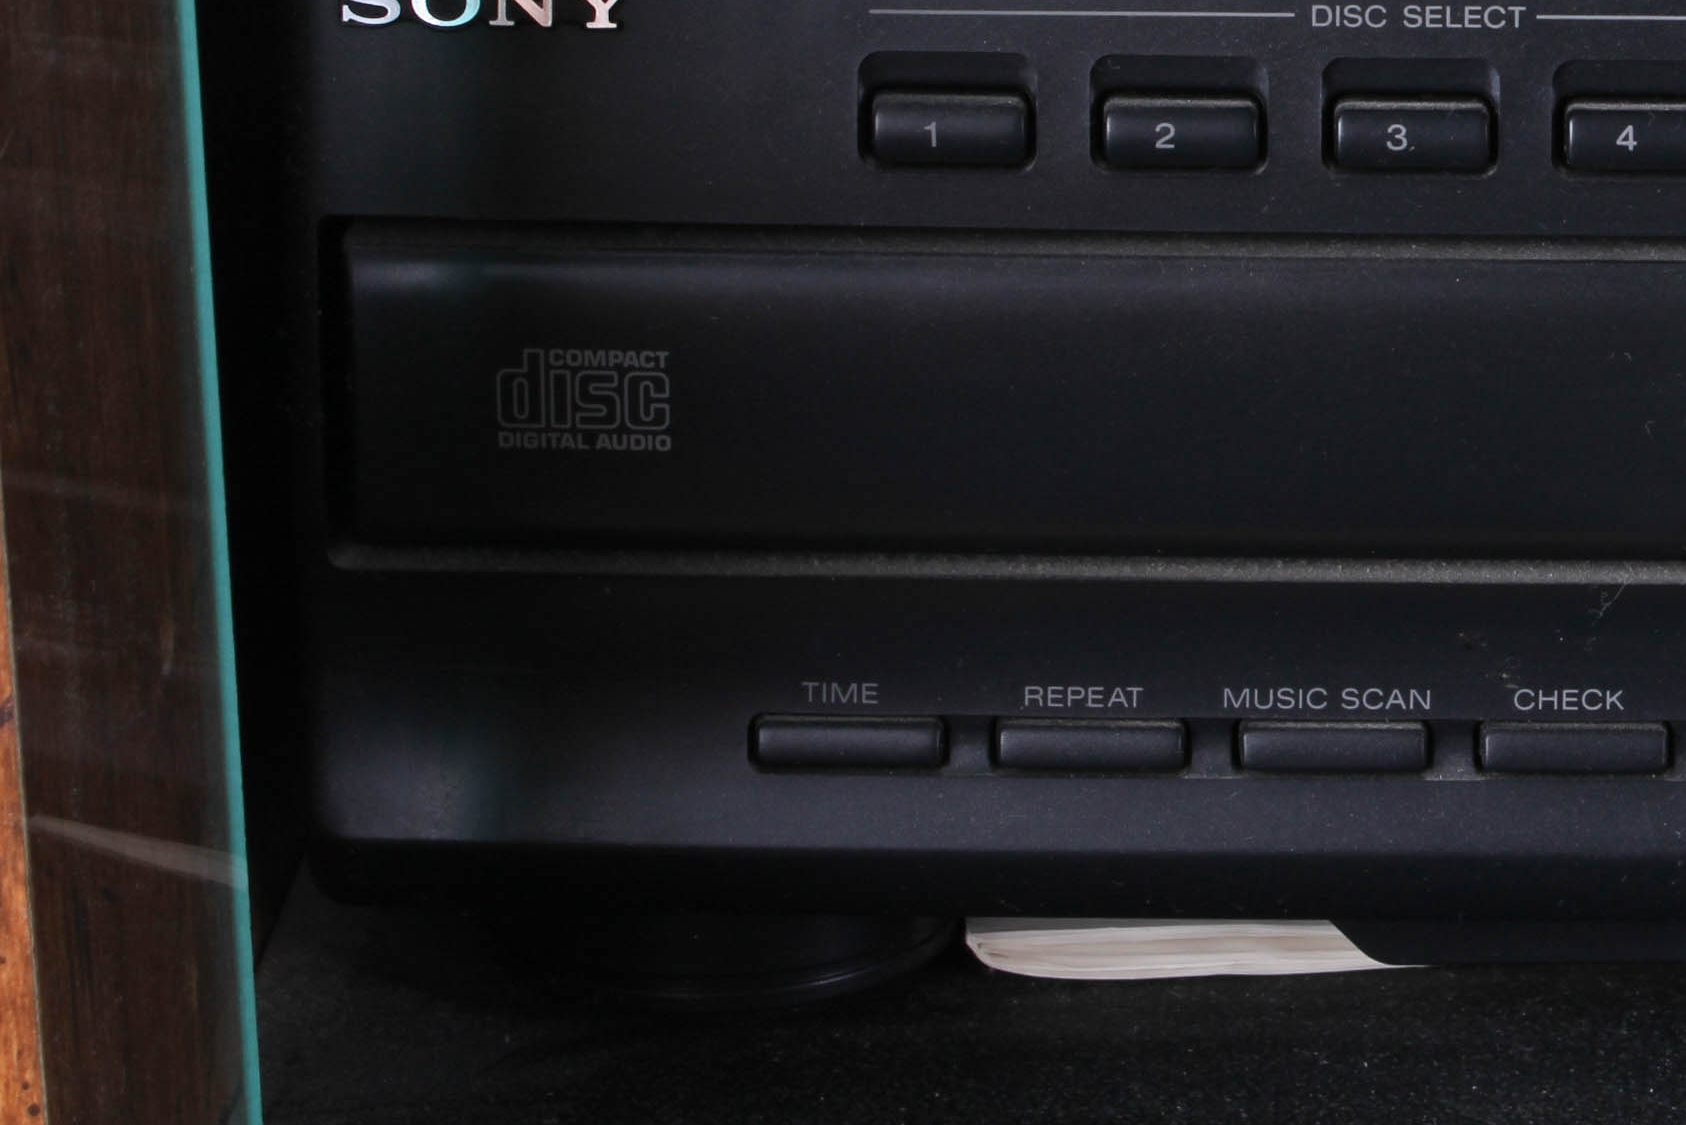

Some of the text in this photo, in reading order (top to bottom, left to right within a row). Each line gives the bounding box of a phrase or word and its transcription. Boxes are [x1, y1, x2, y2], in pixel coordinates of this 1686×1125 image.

[1311, 4, 1527, 29] DISC SELECT
[922, 120, 937, 148] 1
[1154, 122, 1176, 149] 2
[1386, 123, 1406, 151] 3
[1615, 124, 1638, 151] 4
[549, 349, 670, 369] COMPACT
[498, 431, 672, 452] DIGITAL AUDIO
[802, 681, 879, 705] TIME
[1024, 685, 1144, 709] REPEAT
[1223, 687, 1431, 711] MUSIC SCAN
[1513, 688, 1625, 711] CHECK
